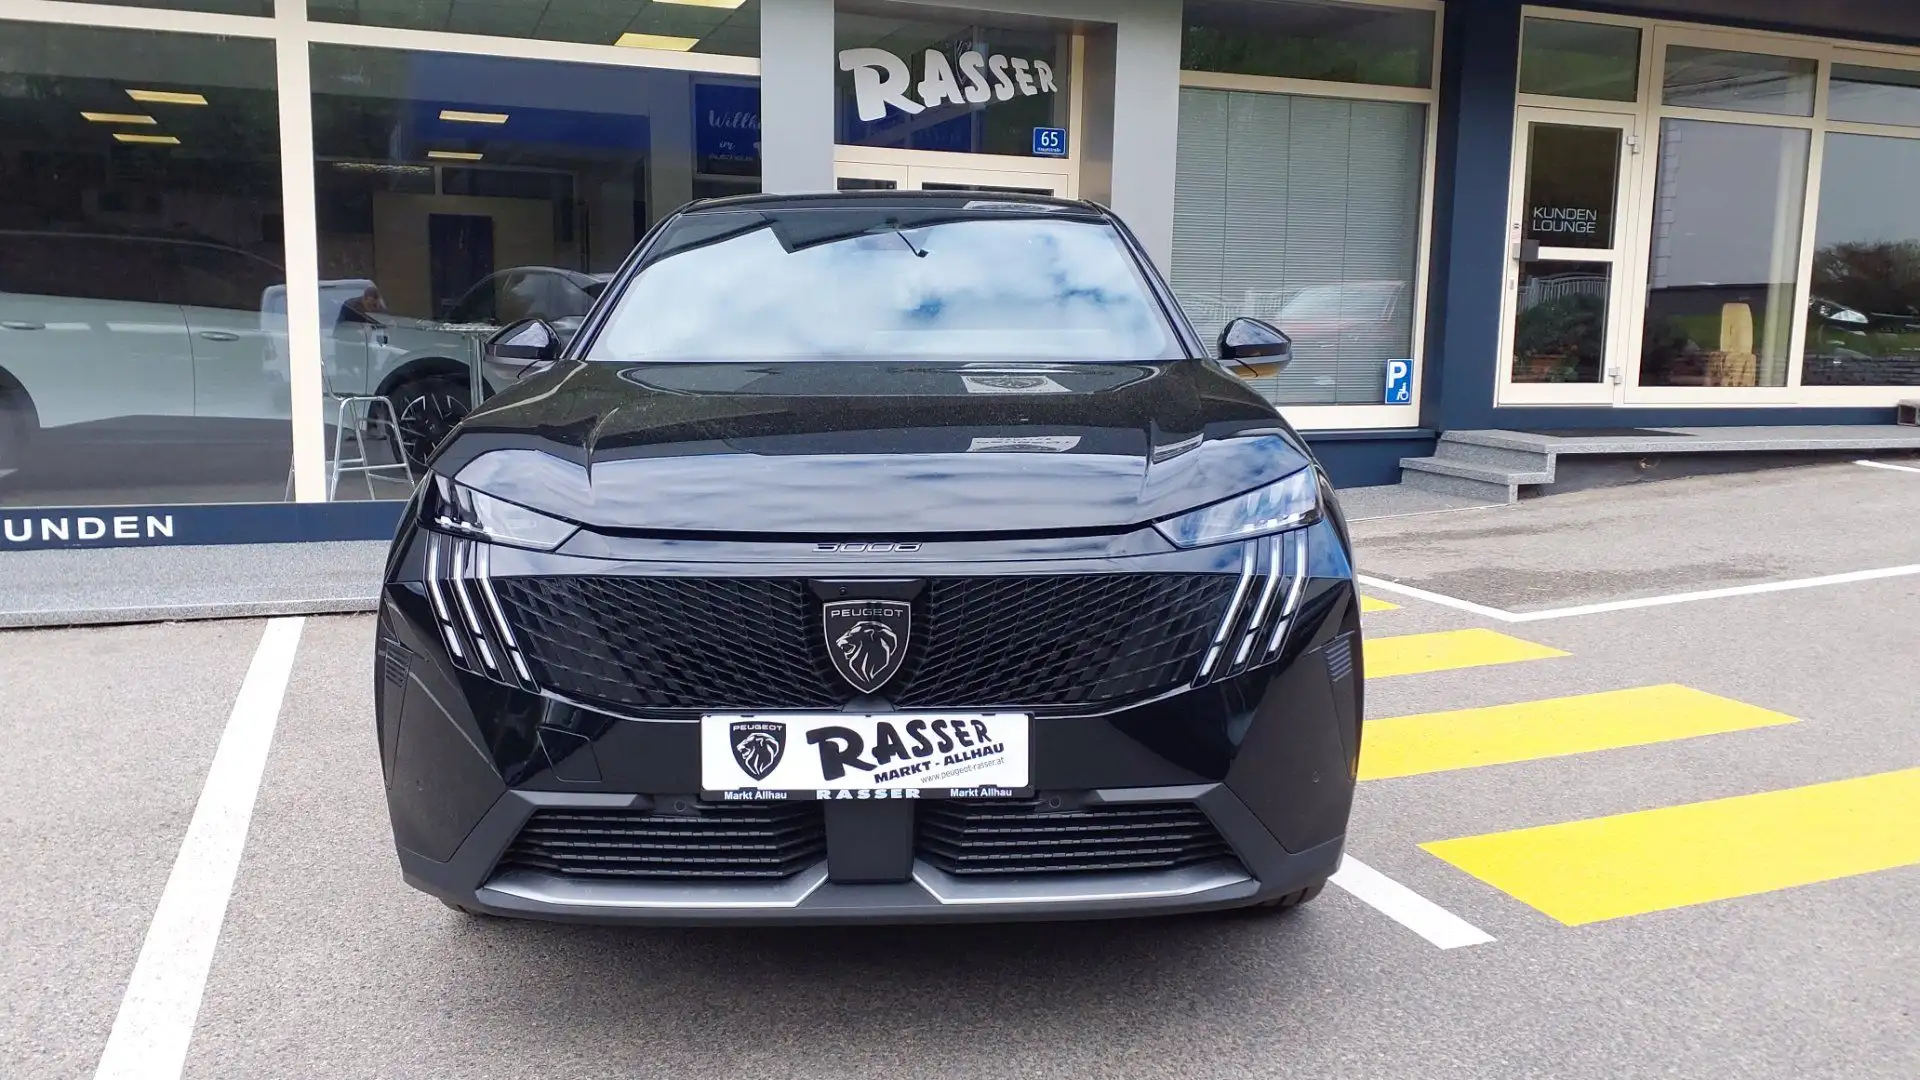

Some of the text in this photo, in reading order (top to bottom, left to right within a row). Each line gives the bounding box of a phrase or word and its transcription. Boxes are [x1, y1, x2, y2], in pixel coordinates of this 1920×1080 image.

[838, 47, 1058, 122] RASSER
[1041, 131, 1059, 147] 65
[1533, 206, 1597, 221] KUNDEN
[1532, 219, 1597, 234] LOUNGE
[1388, 361, 1408, 389] P
[830, 608, 904, 618] PEUGEOT
[732, 723, 783, 732] PEUGEOT
[805, 718, 993, 782] RASSER
[873, 760, 932, 784] MARKT
[943, 742, 1005, 767] ALLHAU
[919, 756, 1006, 784] www.peugeot-rasser.at
[724, 790, 787, 800] Markt Allhau
[816, 788, 921, 800] RASSER
[949, 787, 1013, 798] Markt Allhau
